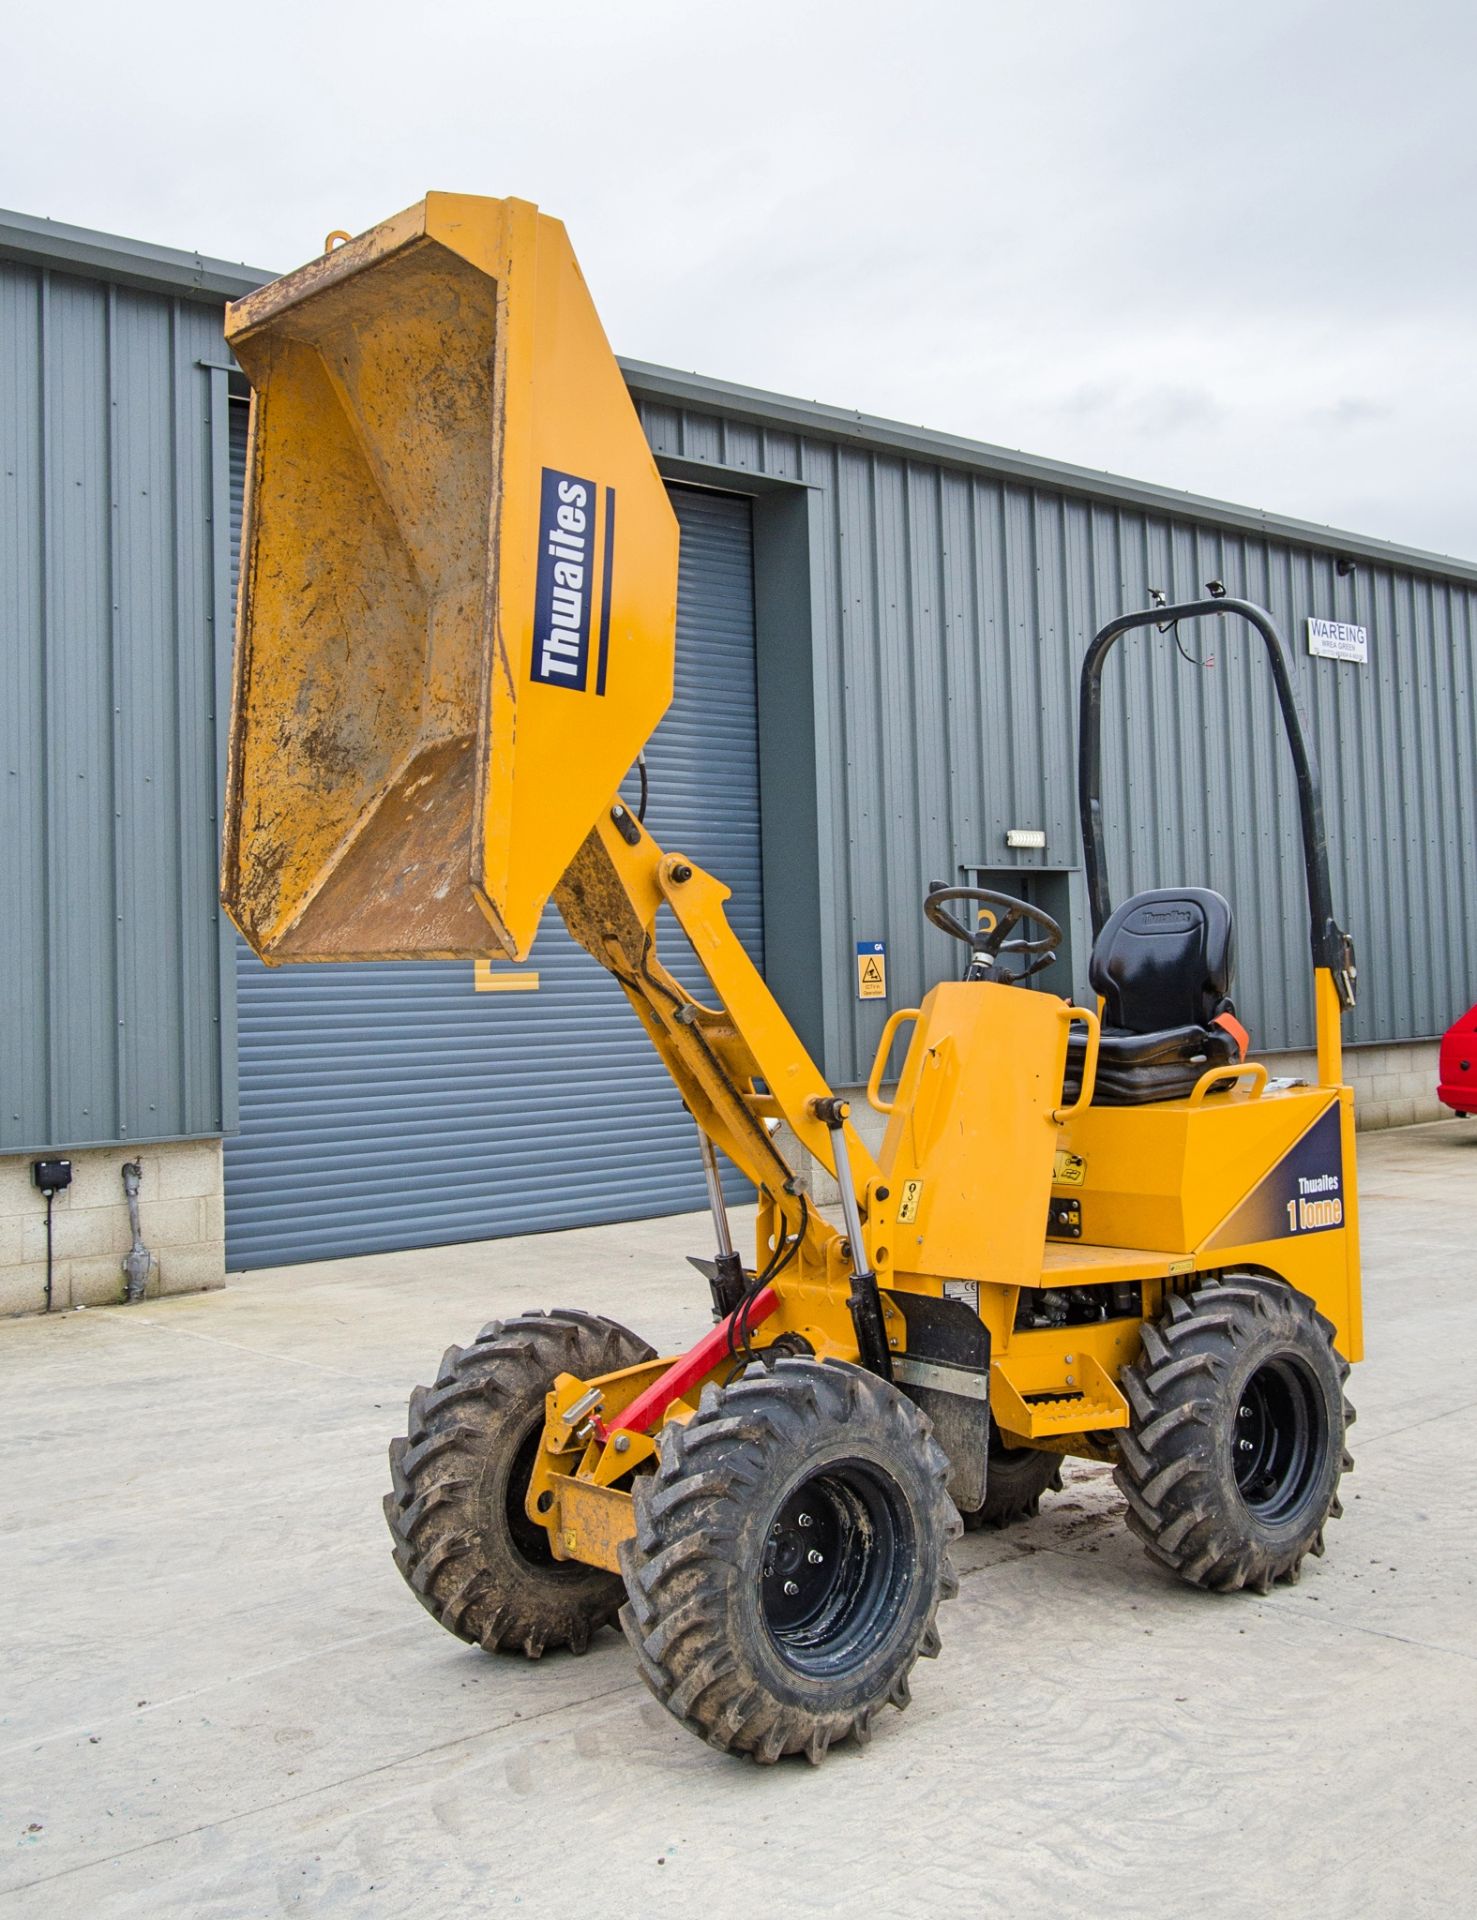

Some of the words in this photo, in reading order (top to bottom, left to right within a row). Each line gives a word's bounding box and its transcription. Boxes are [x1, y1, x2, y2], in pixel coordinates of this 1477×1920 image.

[541, 481, 587, 677] Thwaites
[1311, 620, 1365, 644] WAREING
[1322, 640, 1337, 649] WREA
[1338, 642, 1356, 651] GREEN
[1299, 1174, 1339, 1195] Thwaites
[1287, 1200, 1297, 1231] 1
[1299, 1198, 1342, 1229] tonne
